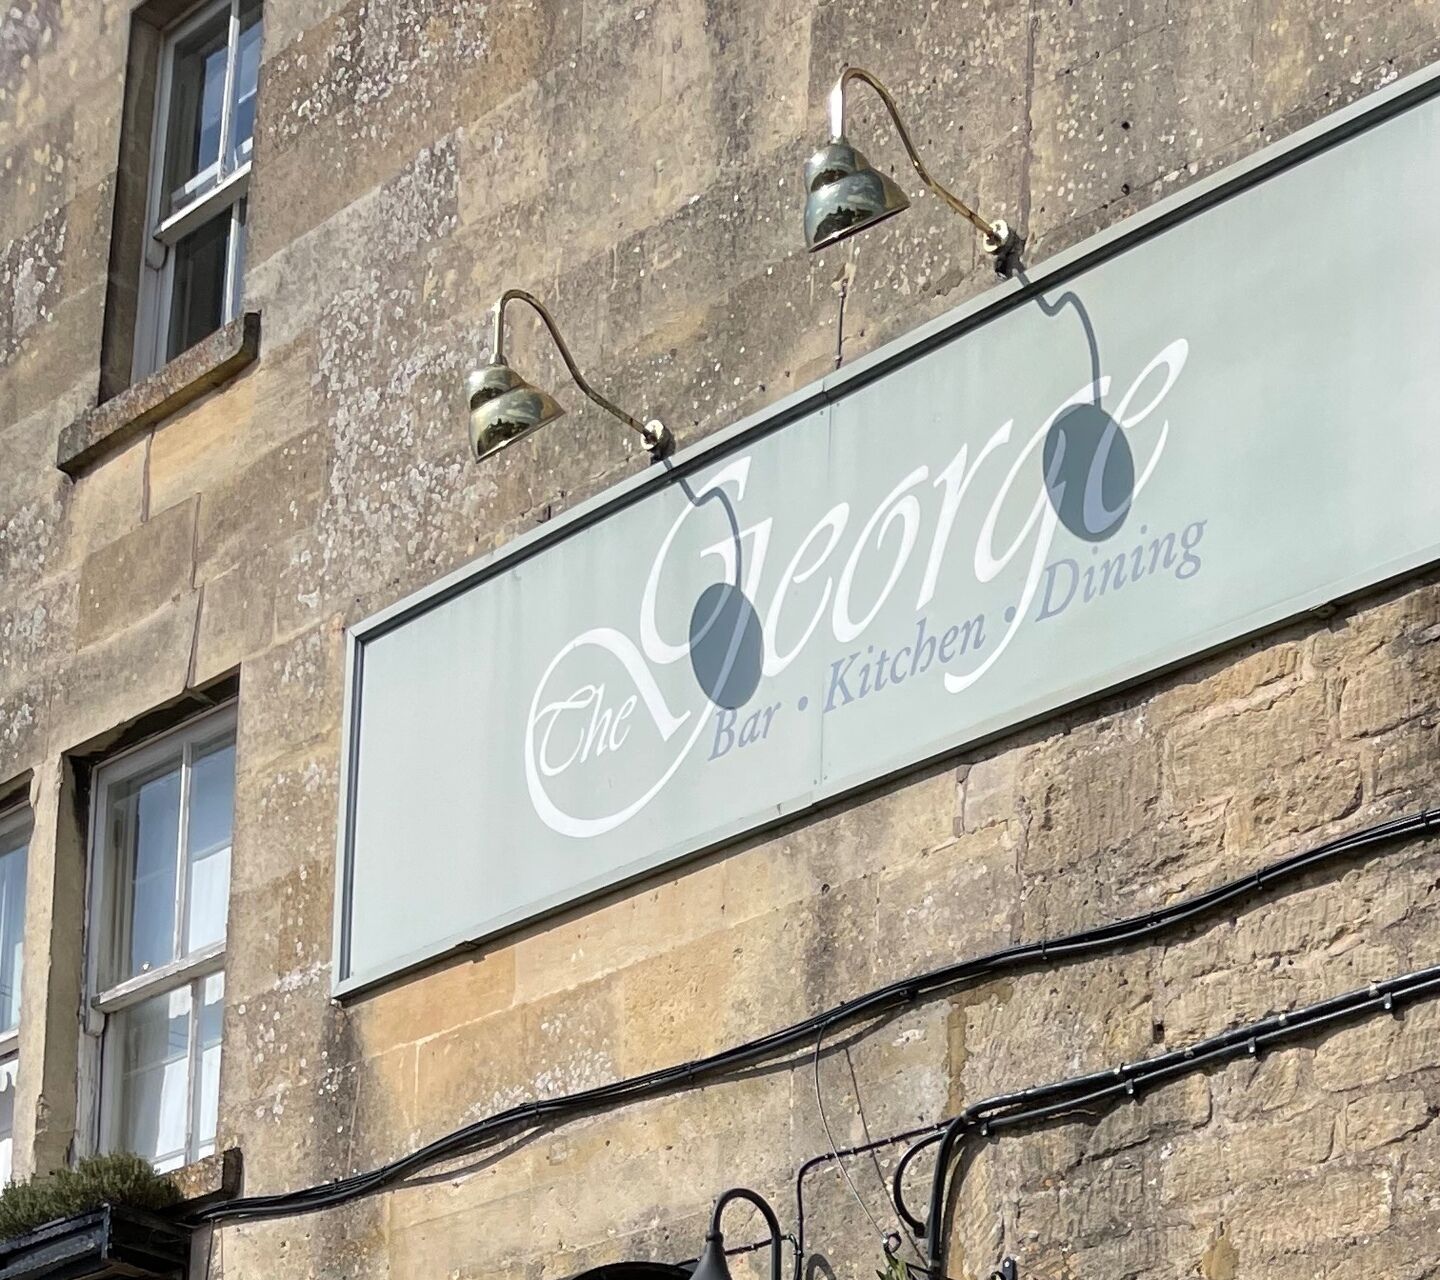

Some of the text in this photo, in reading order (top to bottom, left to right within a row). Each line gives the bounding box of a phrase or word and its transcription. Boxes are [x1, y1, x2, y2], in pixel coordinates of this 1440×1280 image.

[525, 337, 1190, 838] The George
[707, 518, 1209, 762] Bar Kitchen Dining
